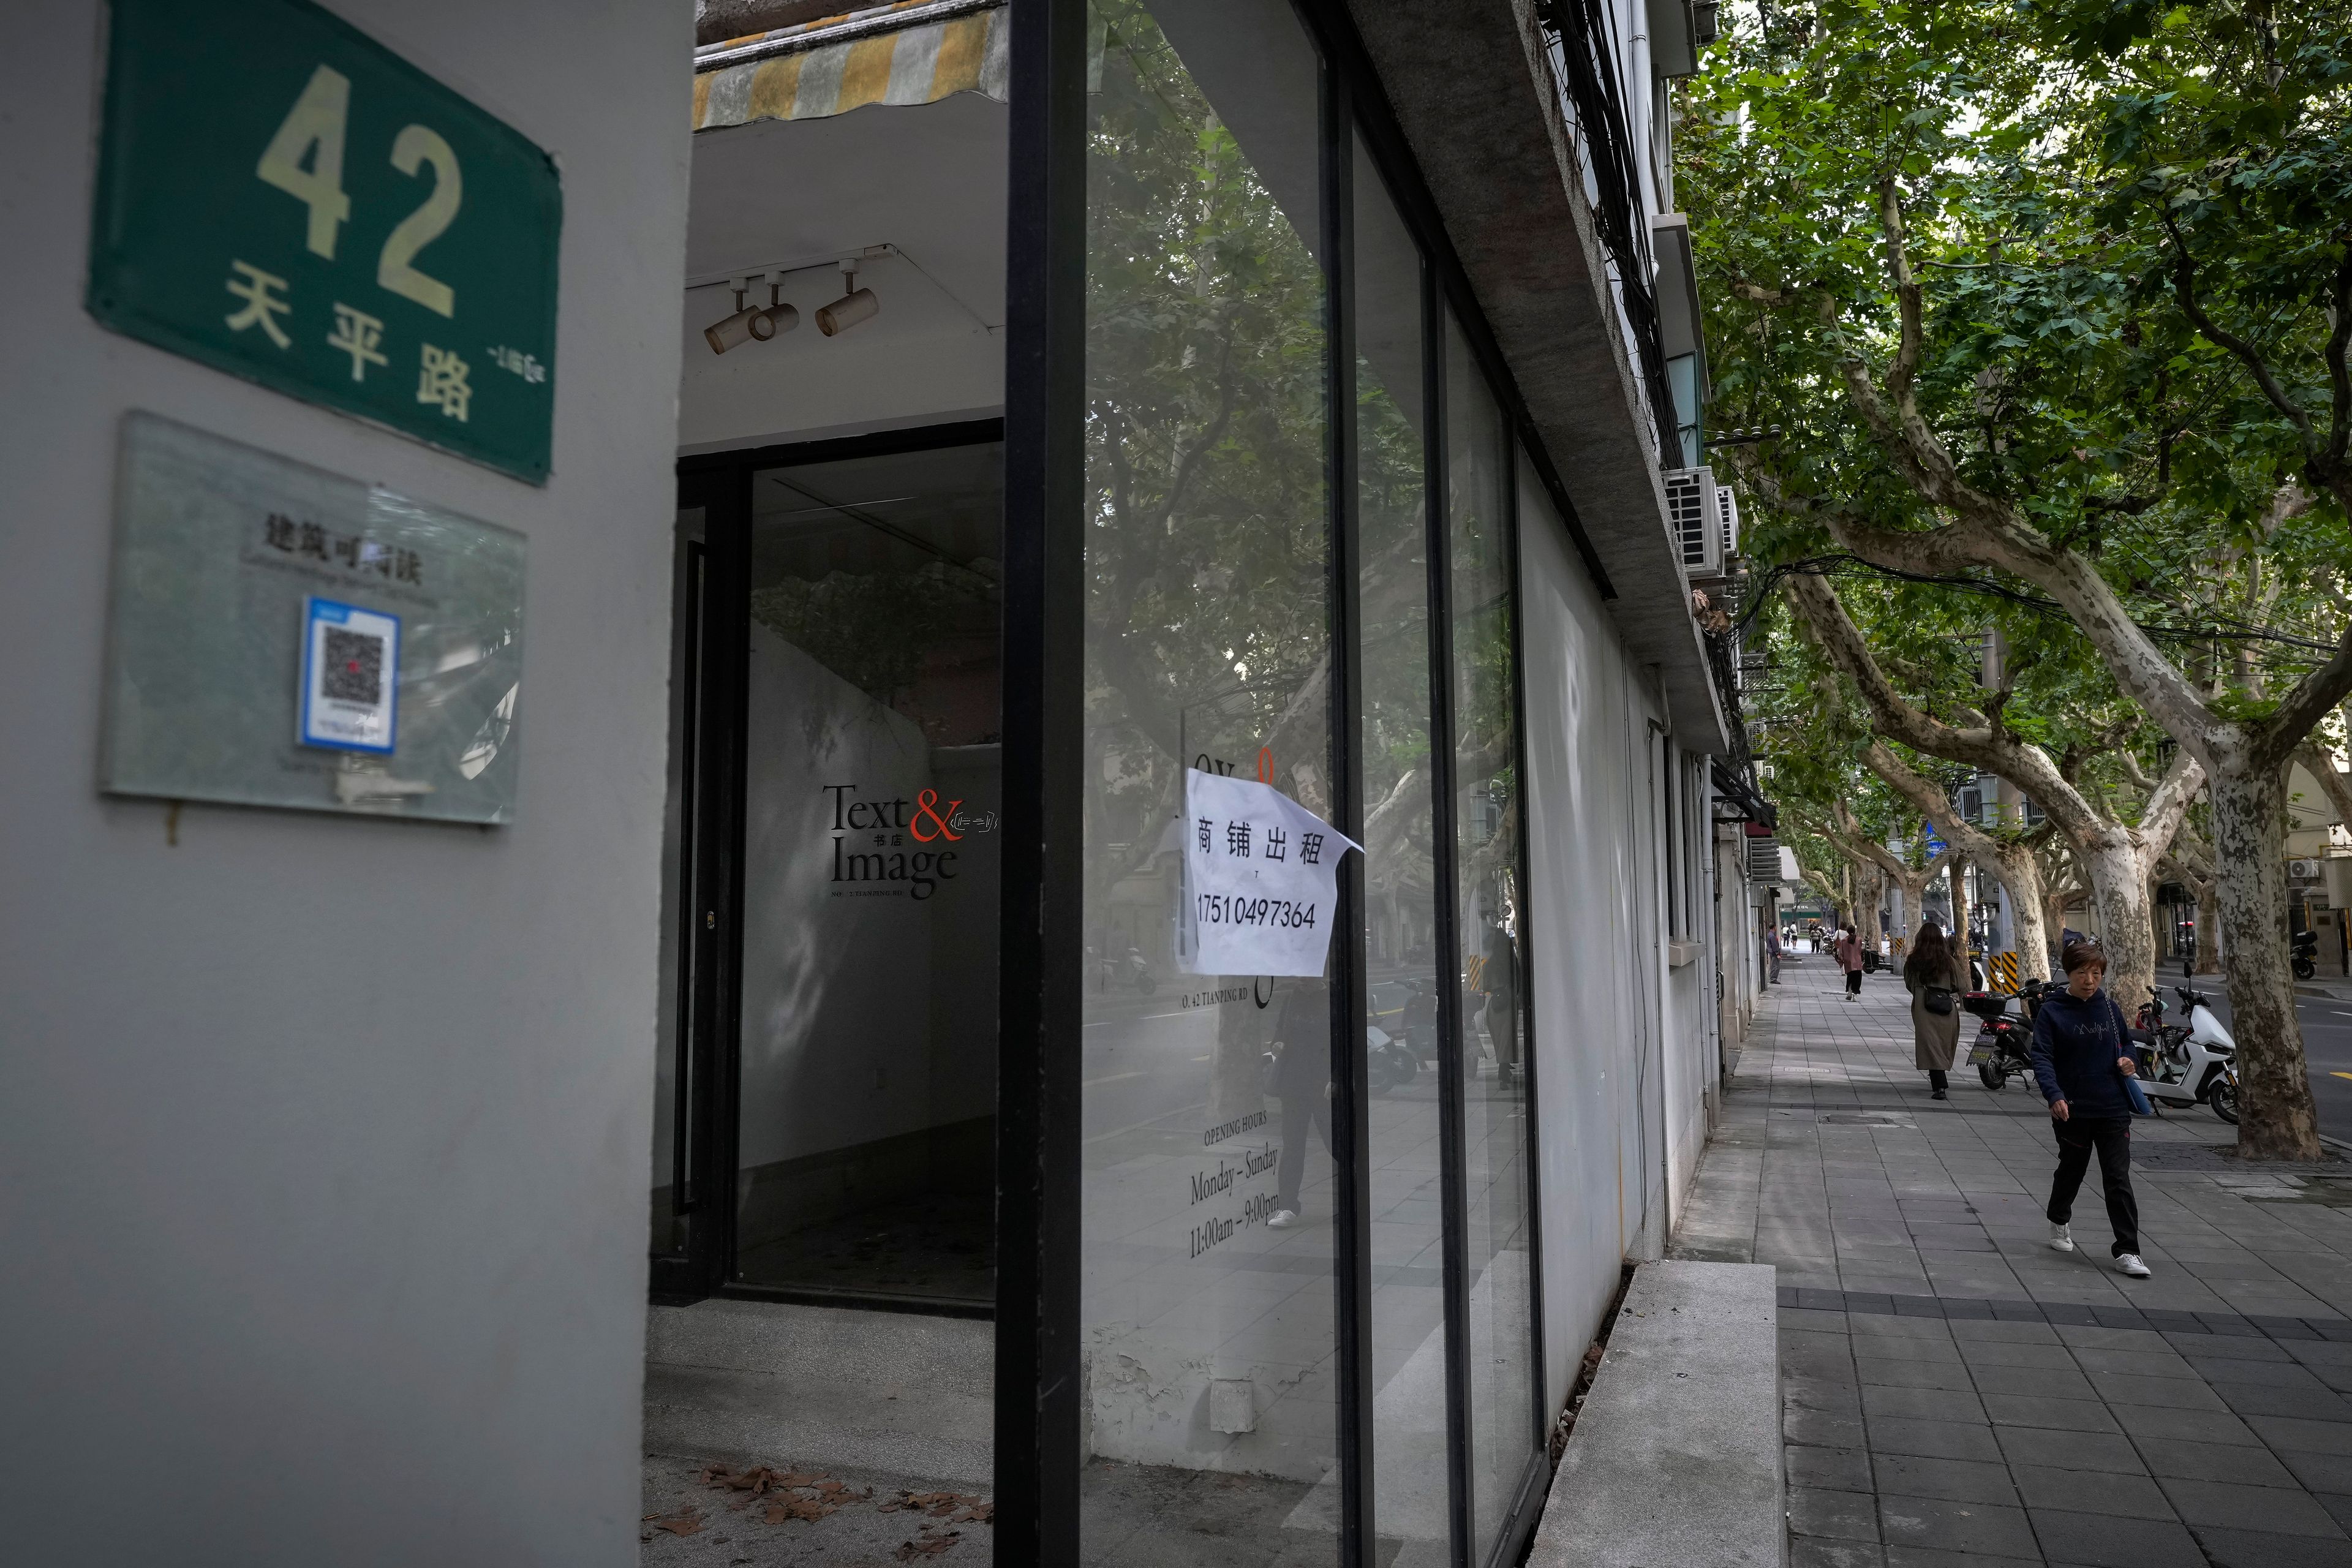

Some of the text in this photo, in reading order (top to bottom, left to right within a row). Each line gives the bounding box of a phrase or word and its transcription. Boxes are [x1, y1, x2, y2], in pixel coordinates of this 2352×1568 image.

[257, 63, 462, 318] 42
[225, 260, 472, 421] 天平路
[823, 785, 964, 842] Text &
[873, 834, 903, 847] 书店
[1199, 816, 1324, 864] 商铺出租
[831, 837, 957, 900] Image
[1198, 893, 1315, 929] 17510497364
[1202, 989, 1237, 1005] TIANPING
[1238, 987, 1248, 1000] RD
[1204, 1110, 1267, 1146] OPENING HOURS
[1191, 1161, 1234, 1205] Monday
[1246, 1142, 1277, 1178] Sunday
[1191, 1217, 1233, 1259] 11:00am
[1245, 1193, 1279, 1229] 9:00pm
